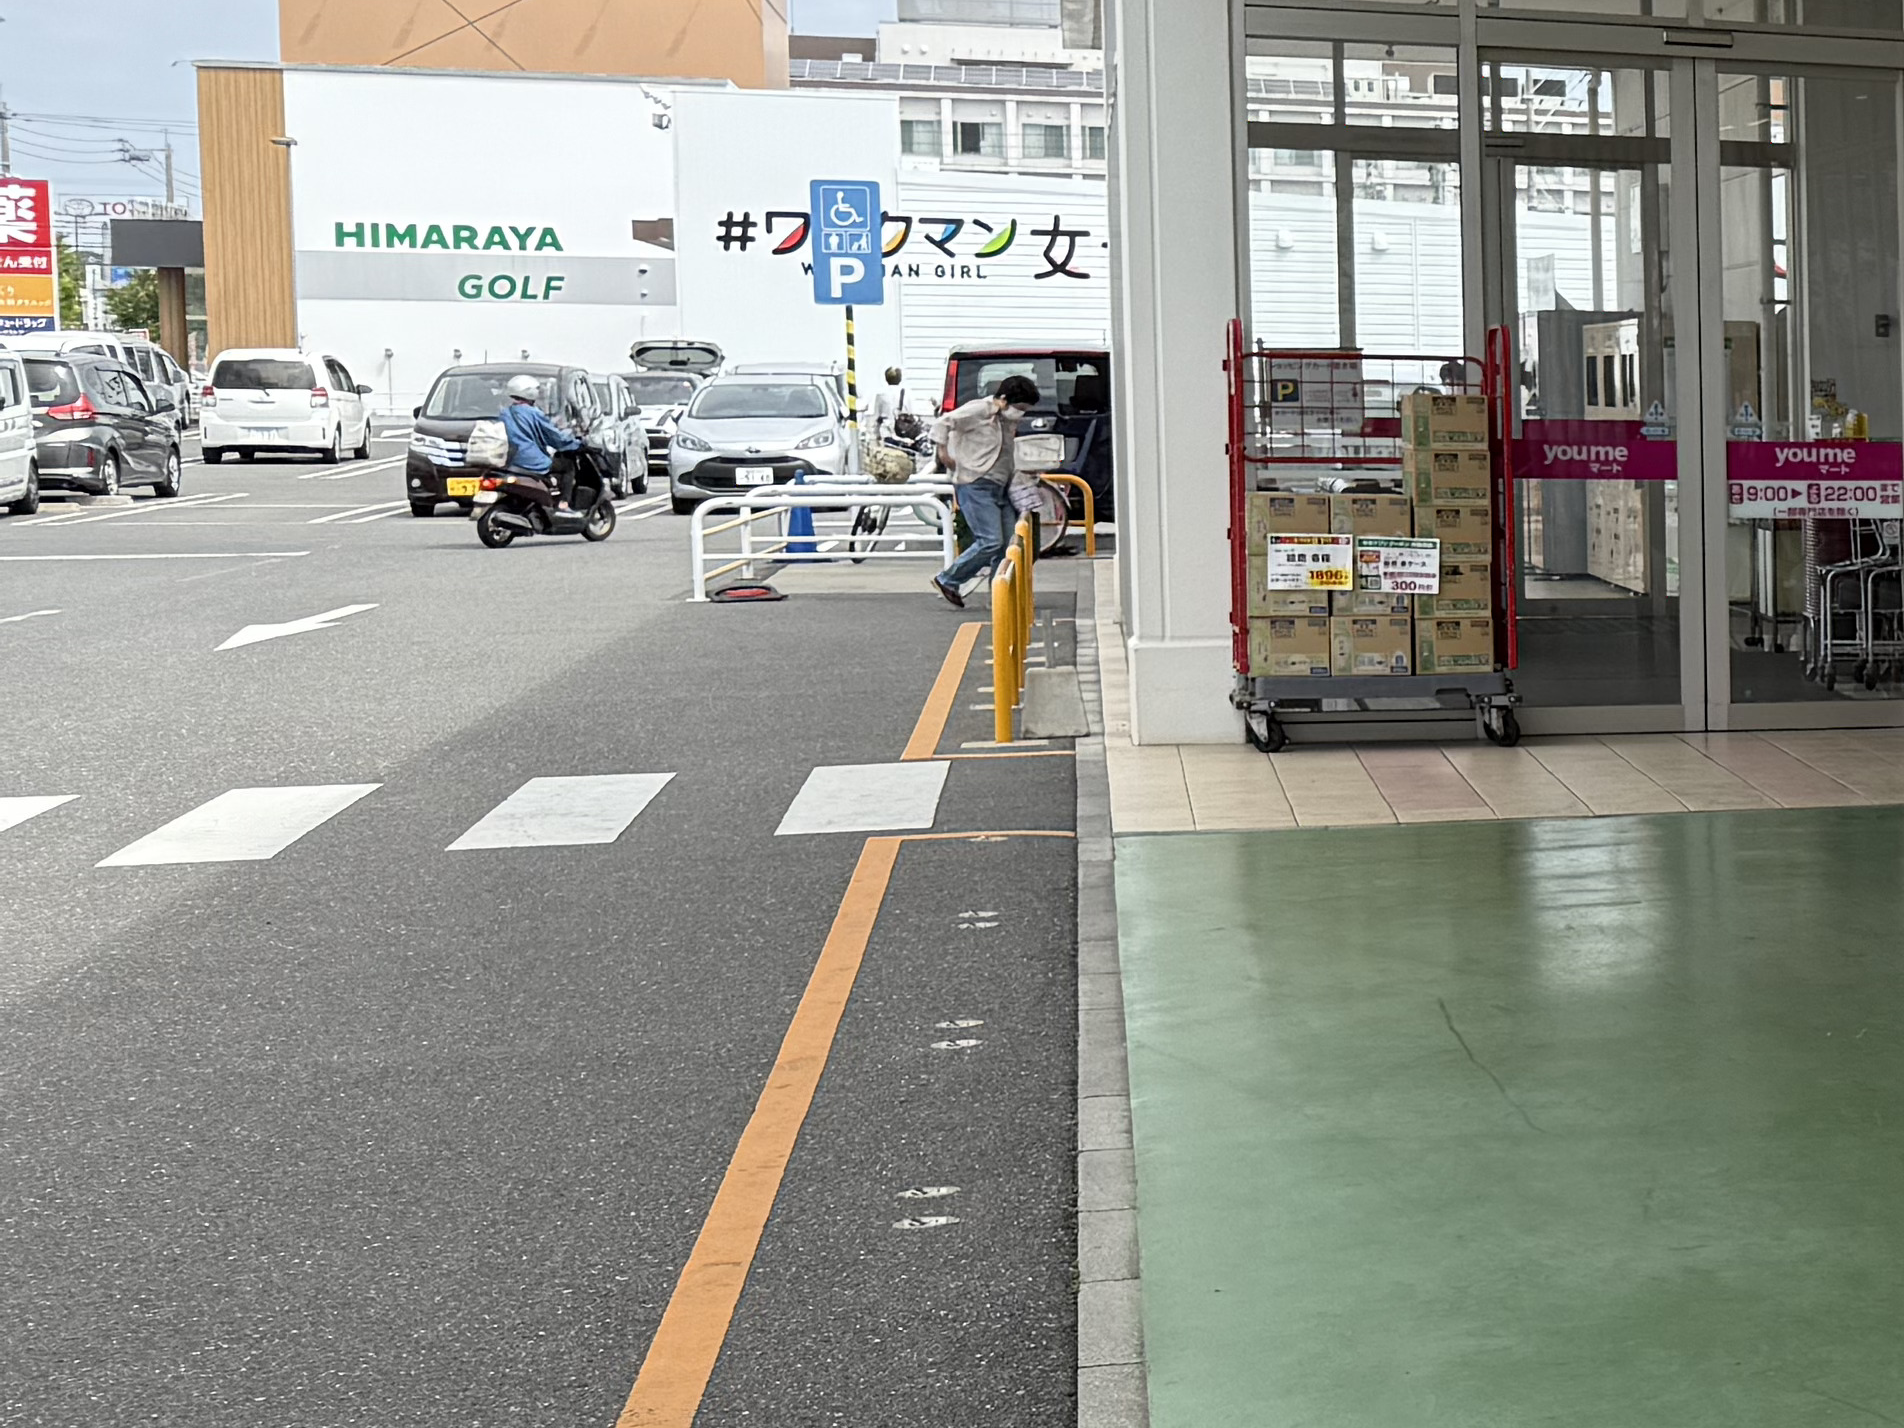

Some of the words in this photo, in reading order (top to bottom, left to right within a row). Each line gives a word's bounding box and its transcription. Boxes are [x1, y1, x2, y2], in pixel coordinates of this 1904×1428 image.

[335, 222, 564, 251] HIMARAYA
[830, 256, 865, 299] P
[934, 264, 988, 279] GIRL
[457, 274, 565, 301] GOLF
[1277, 382, 1295, 401] P
[1543, 443, 1629, 465] youme
[1775, 444, 1856, 467] youme
[1588, 462, 1622, 474] マート
[1818, 464, 1850, 475] マート
[1747, 485, 1788, 502] 9:00
[1824, 486, 1878, 502] 22:00
